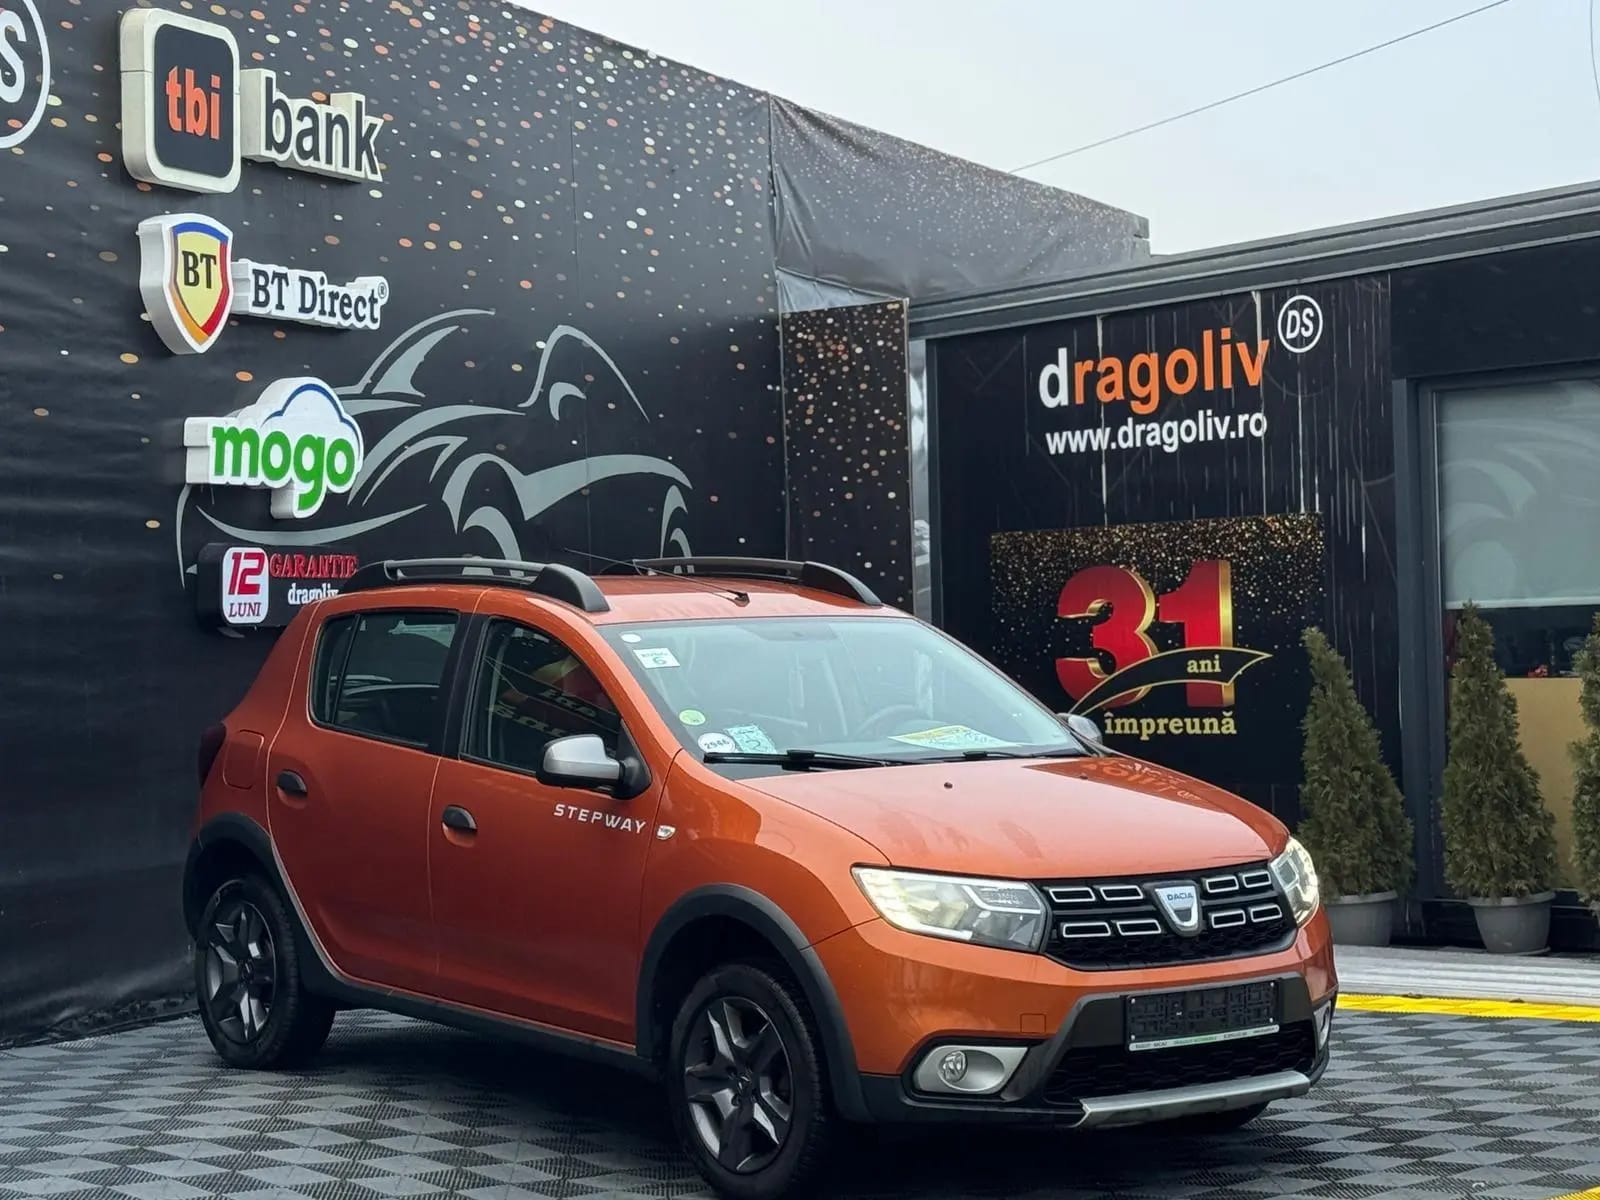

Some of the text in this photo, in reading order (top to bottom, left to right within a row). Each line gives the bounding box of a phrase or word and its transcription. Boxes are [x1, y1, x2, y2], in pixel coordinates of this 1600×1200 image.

[165, 66, 383, 177] tbi bank
[182, 250, 217, 289] BT
[252, 269, 289, 311] BT
[1285, 307, 1315, 340] DS
[1039, 327, 1270, 415] dragoliv
[1045, 409, 1268, 455] www.dragoliv.ro
[212, 425, 355, 511] mogo
[228, 551, 265, 596] 12
[228, 602, 262, 618] LUNI
[1055, 560, 1236, 709] 31
[1187, 654, 1222, 674] ani
[1104, 711, 1237, 741] împreună
[553, 803, 647, 835] STEPWAY
[1166, 892, 1194, 901] DACIA
